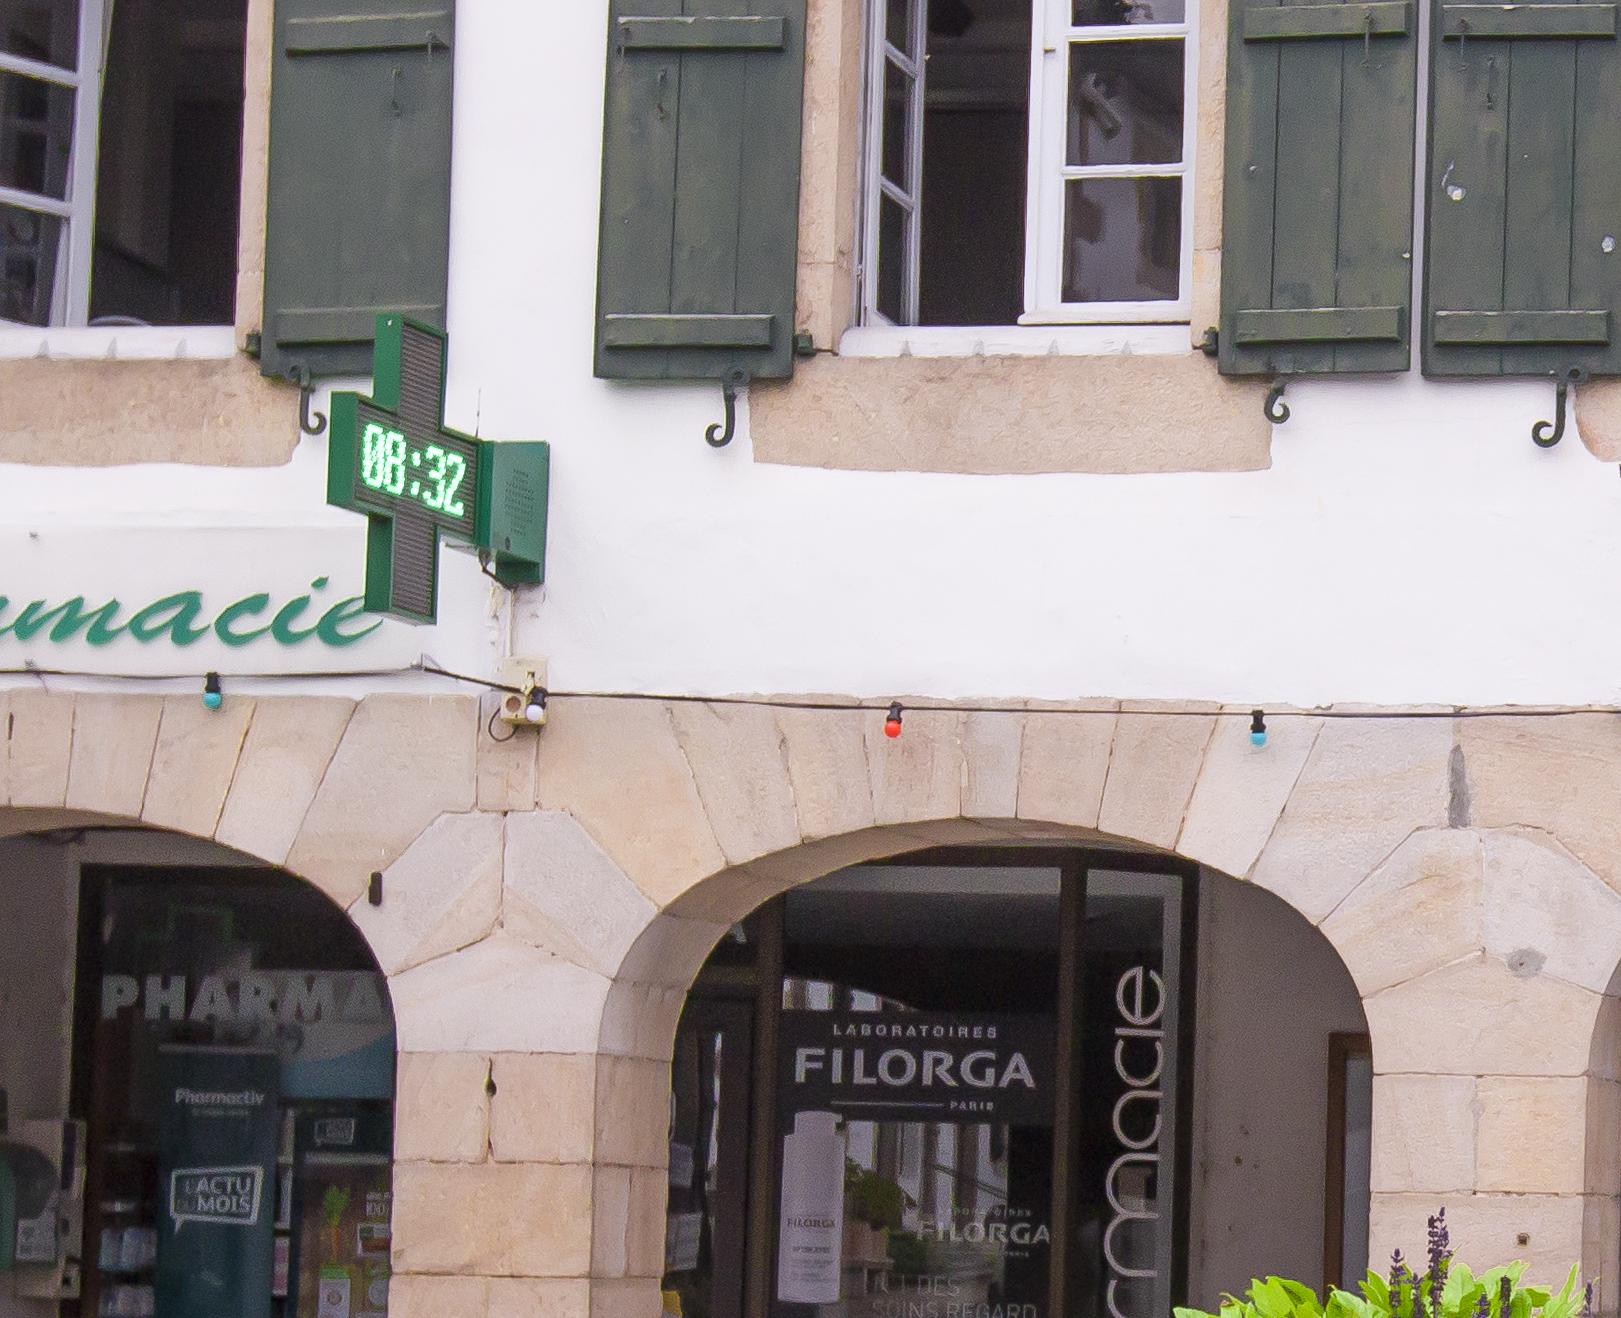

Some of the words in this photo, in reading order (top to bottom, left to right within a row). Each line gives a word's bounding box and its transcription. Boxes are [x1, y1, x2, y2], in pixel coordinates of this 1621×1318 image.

[832, 1022, 998, 1039] LABORATOIRES
[793, 1047, 1037, 1089] FILORGA
[196, 1195, 250, 1214] MOIS
[916, 1221, 1050, 1245] FILORGA
